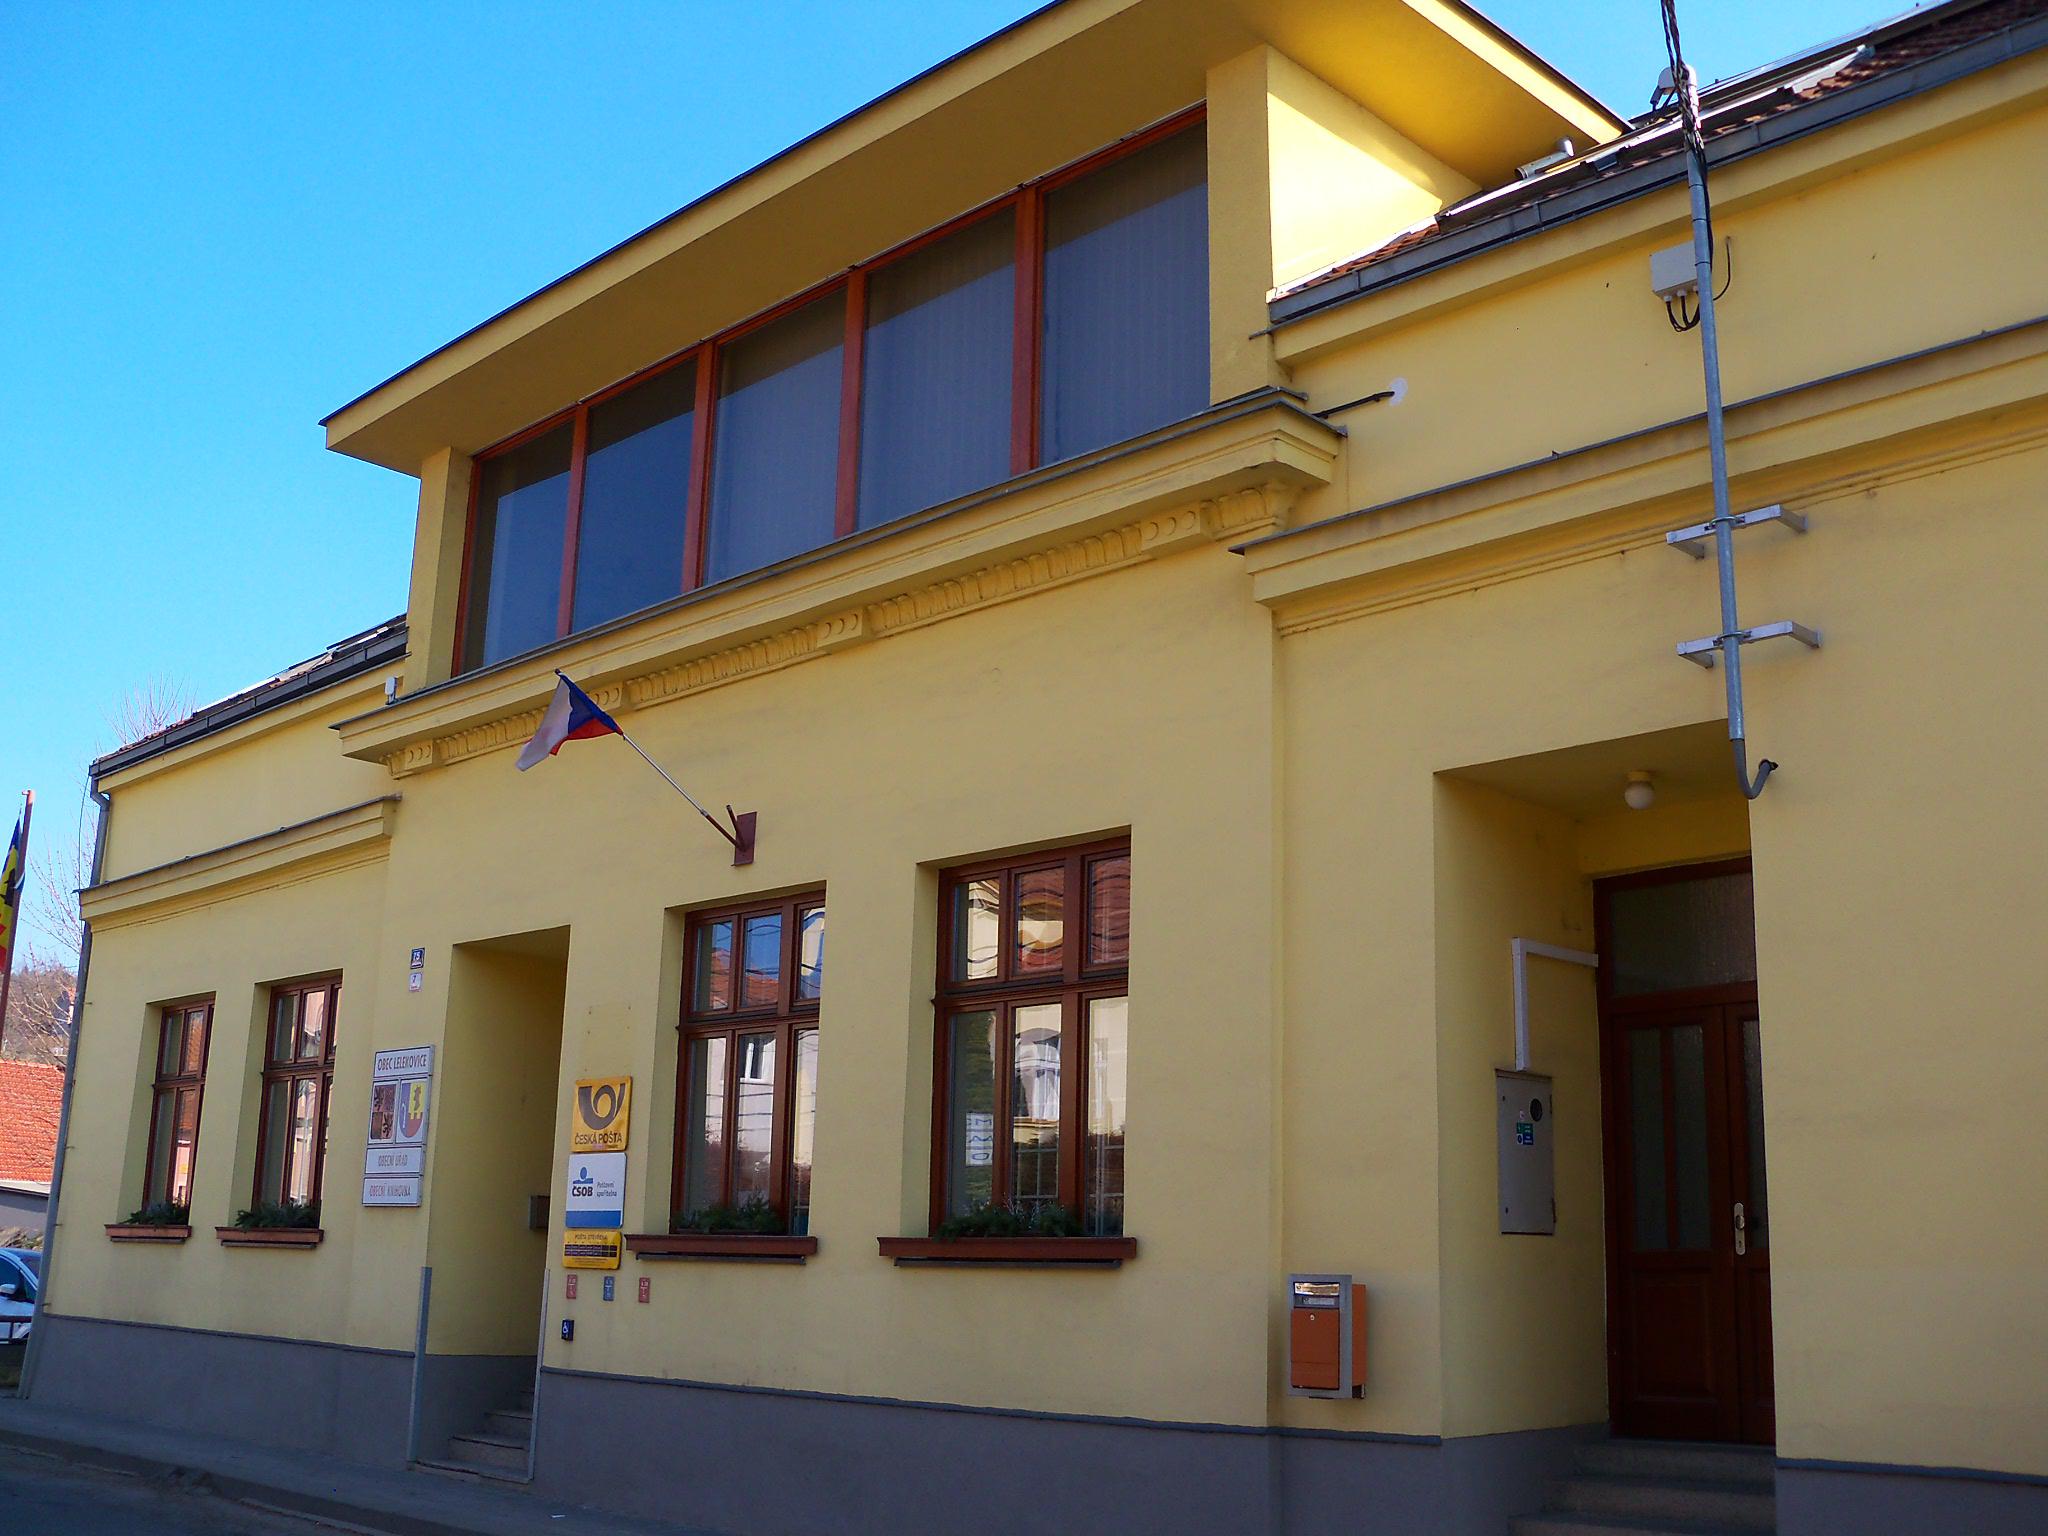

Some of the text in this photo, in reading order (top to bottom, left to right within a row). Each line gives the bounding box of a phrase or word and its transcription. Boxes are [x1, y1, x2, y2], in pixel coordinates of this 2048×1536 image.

[377, 1054, 427, 1071] OBEC LELEKOVICE
[575, 1130, 623, 1145] ČESKÁ POŠTA
[572, 1185, 593, 1197] ČSOB
